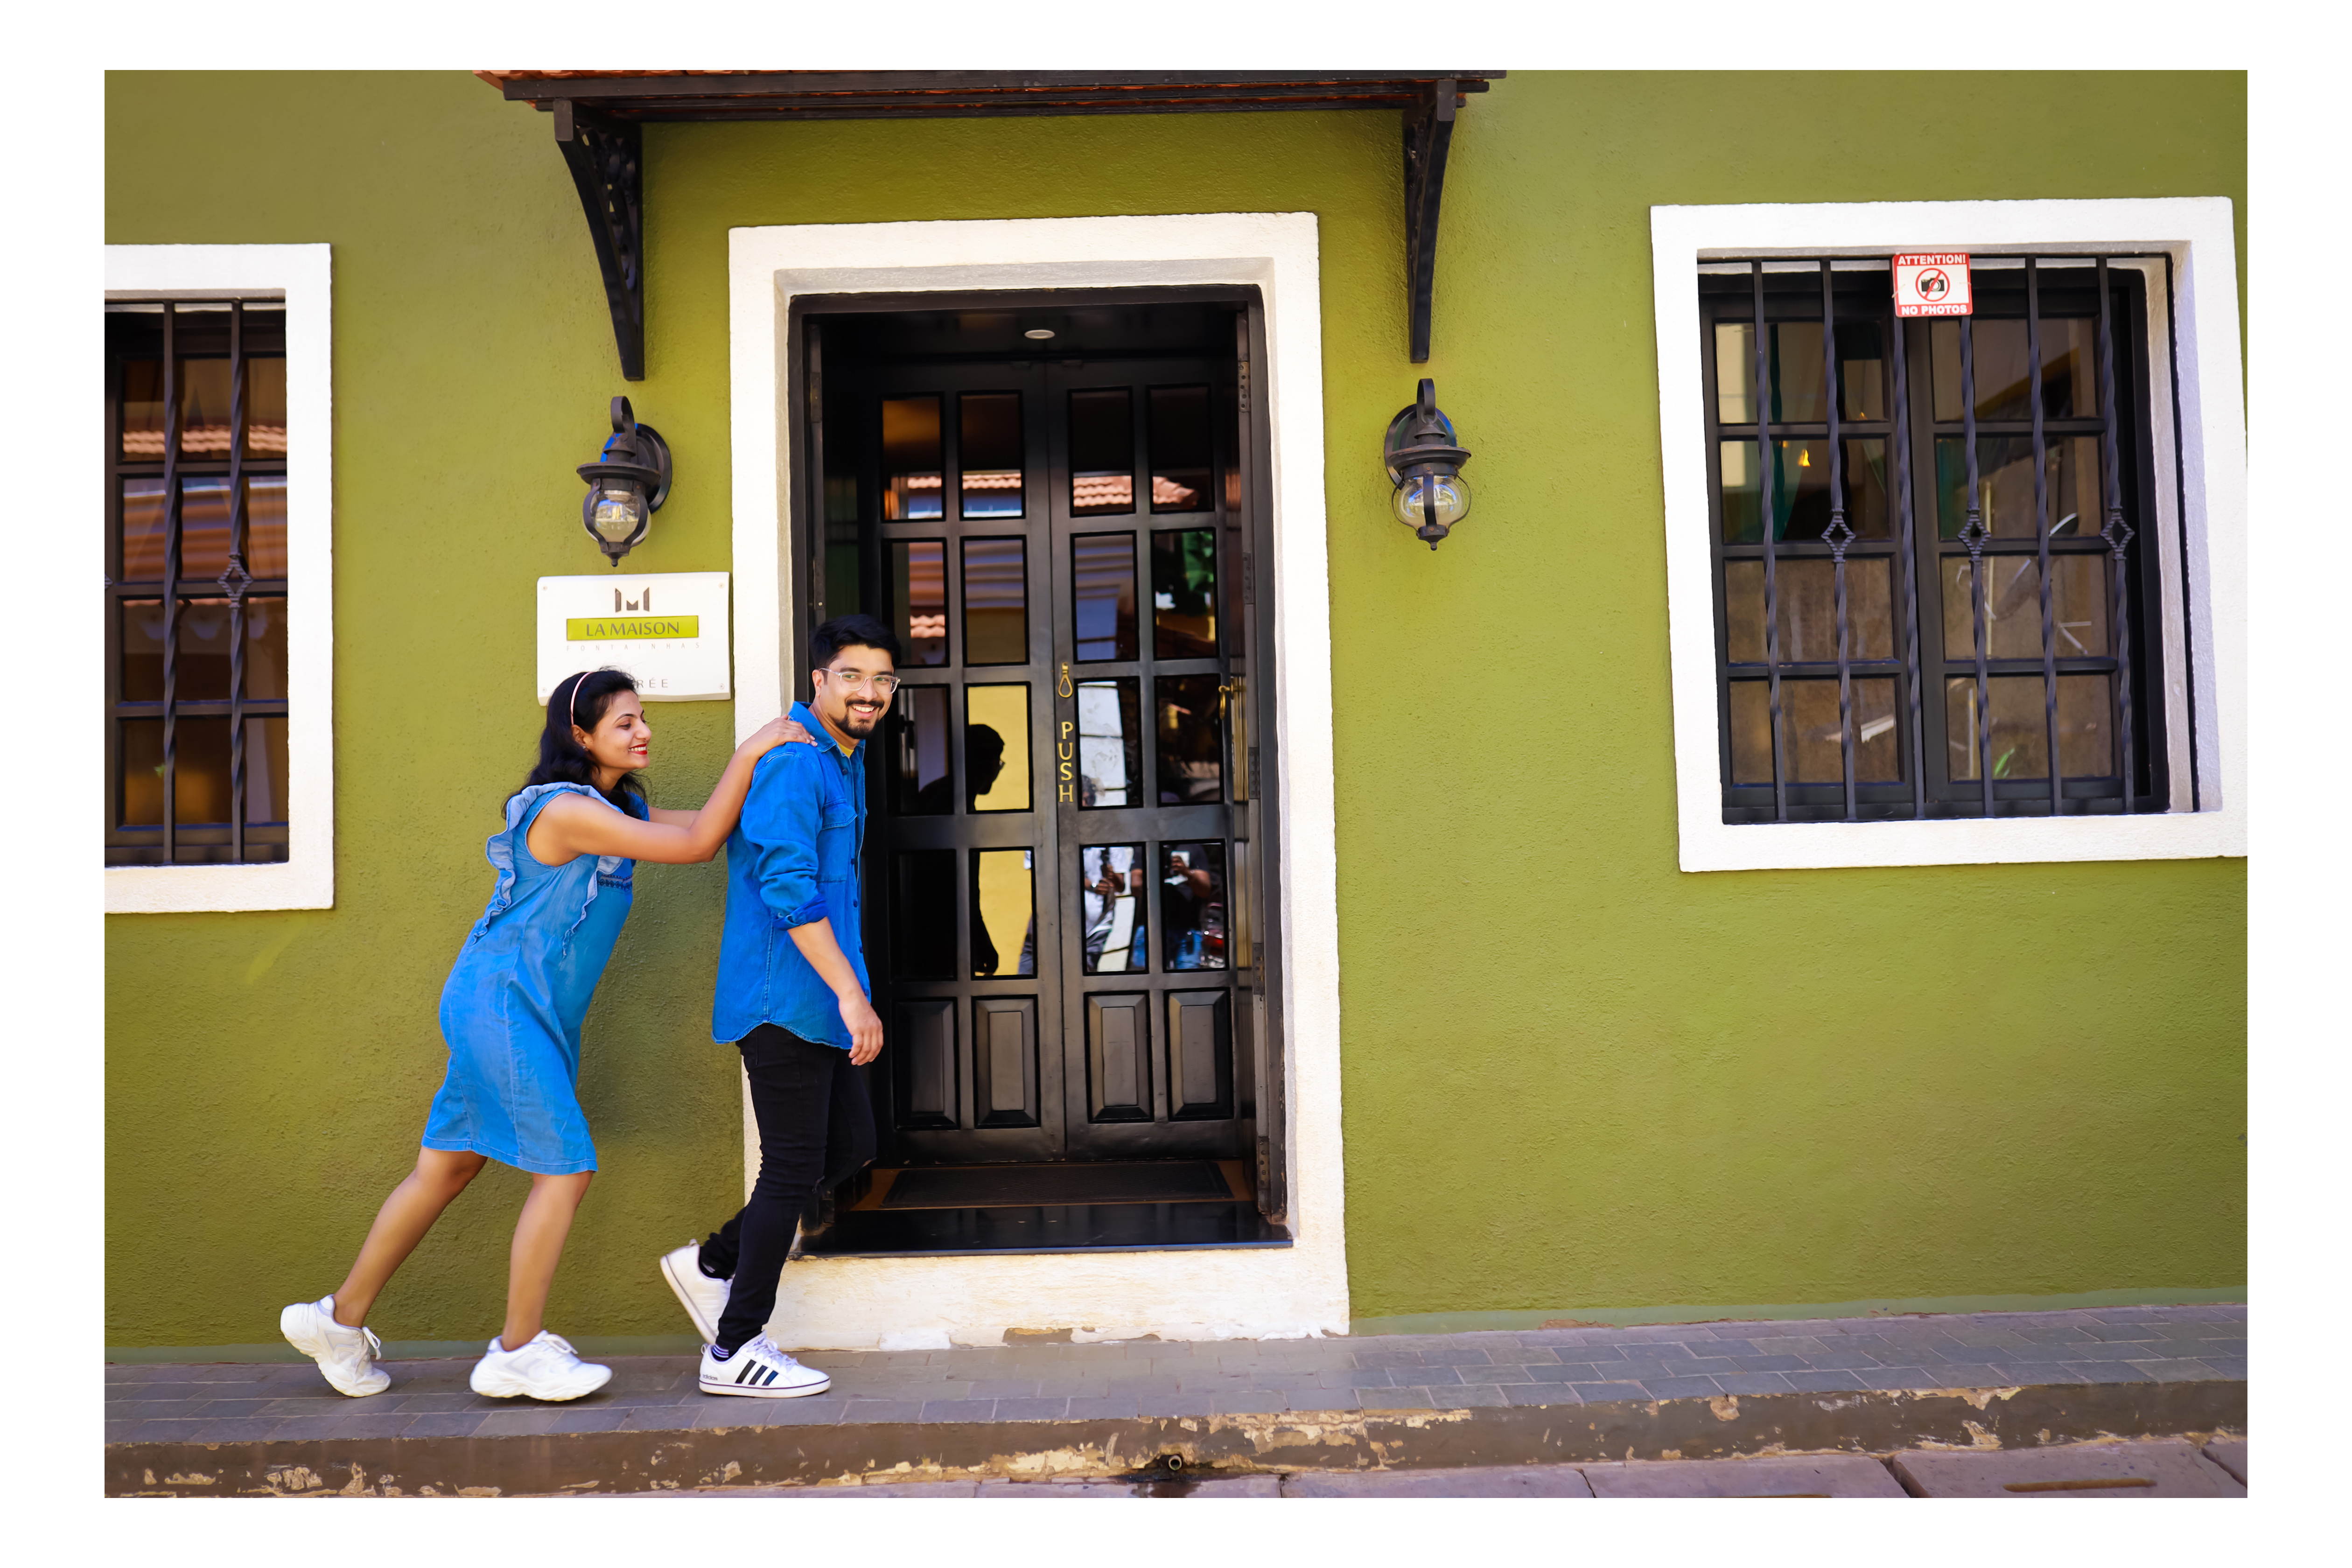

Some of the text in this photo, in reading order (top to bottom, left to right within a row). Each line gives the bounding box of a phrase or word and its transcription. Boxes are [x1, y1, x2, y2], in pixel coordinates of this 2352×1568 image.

[1898, 254, 1966, 265] ATTENTION!
[1901, 304, 1967, 315] NO PHOTOS
[587, 622, 679, 636] LA MAISON
[567, 642, 699, 651] FONTAINHAS
[636, 677, 668, 688] RÉE
[1058, 721, 1073, 802] PUSH
